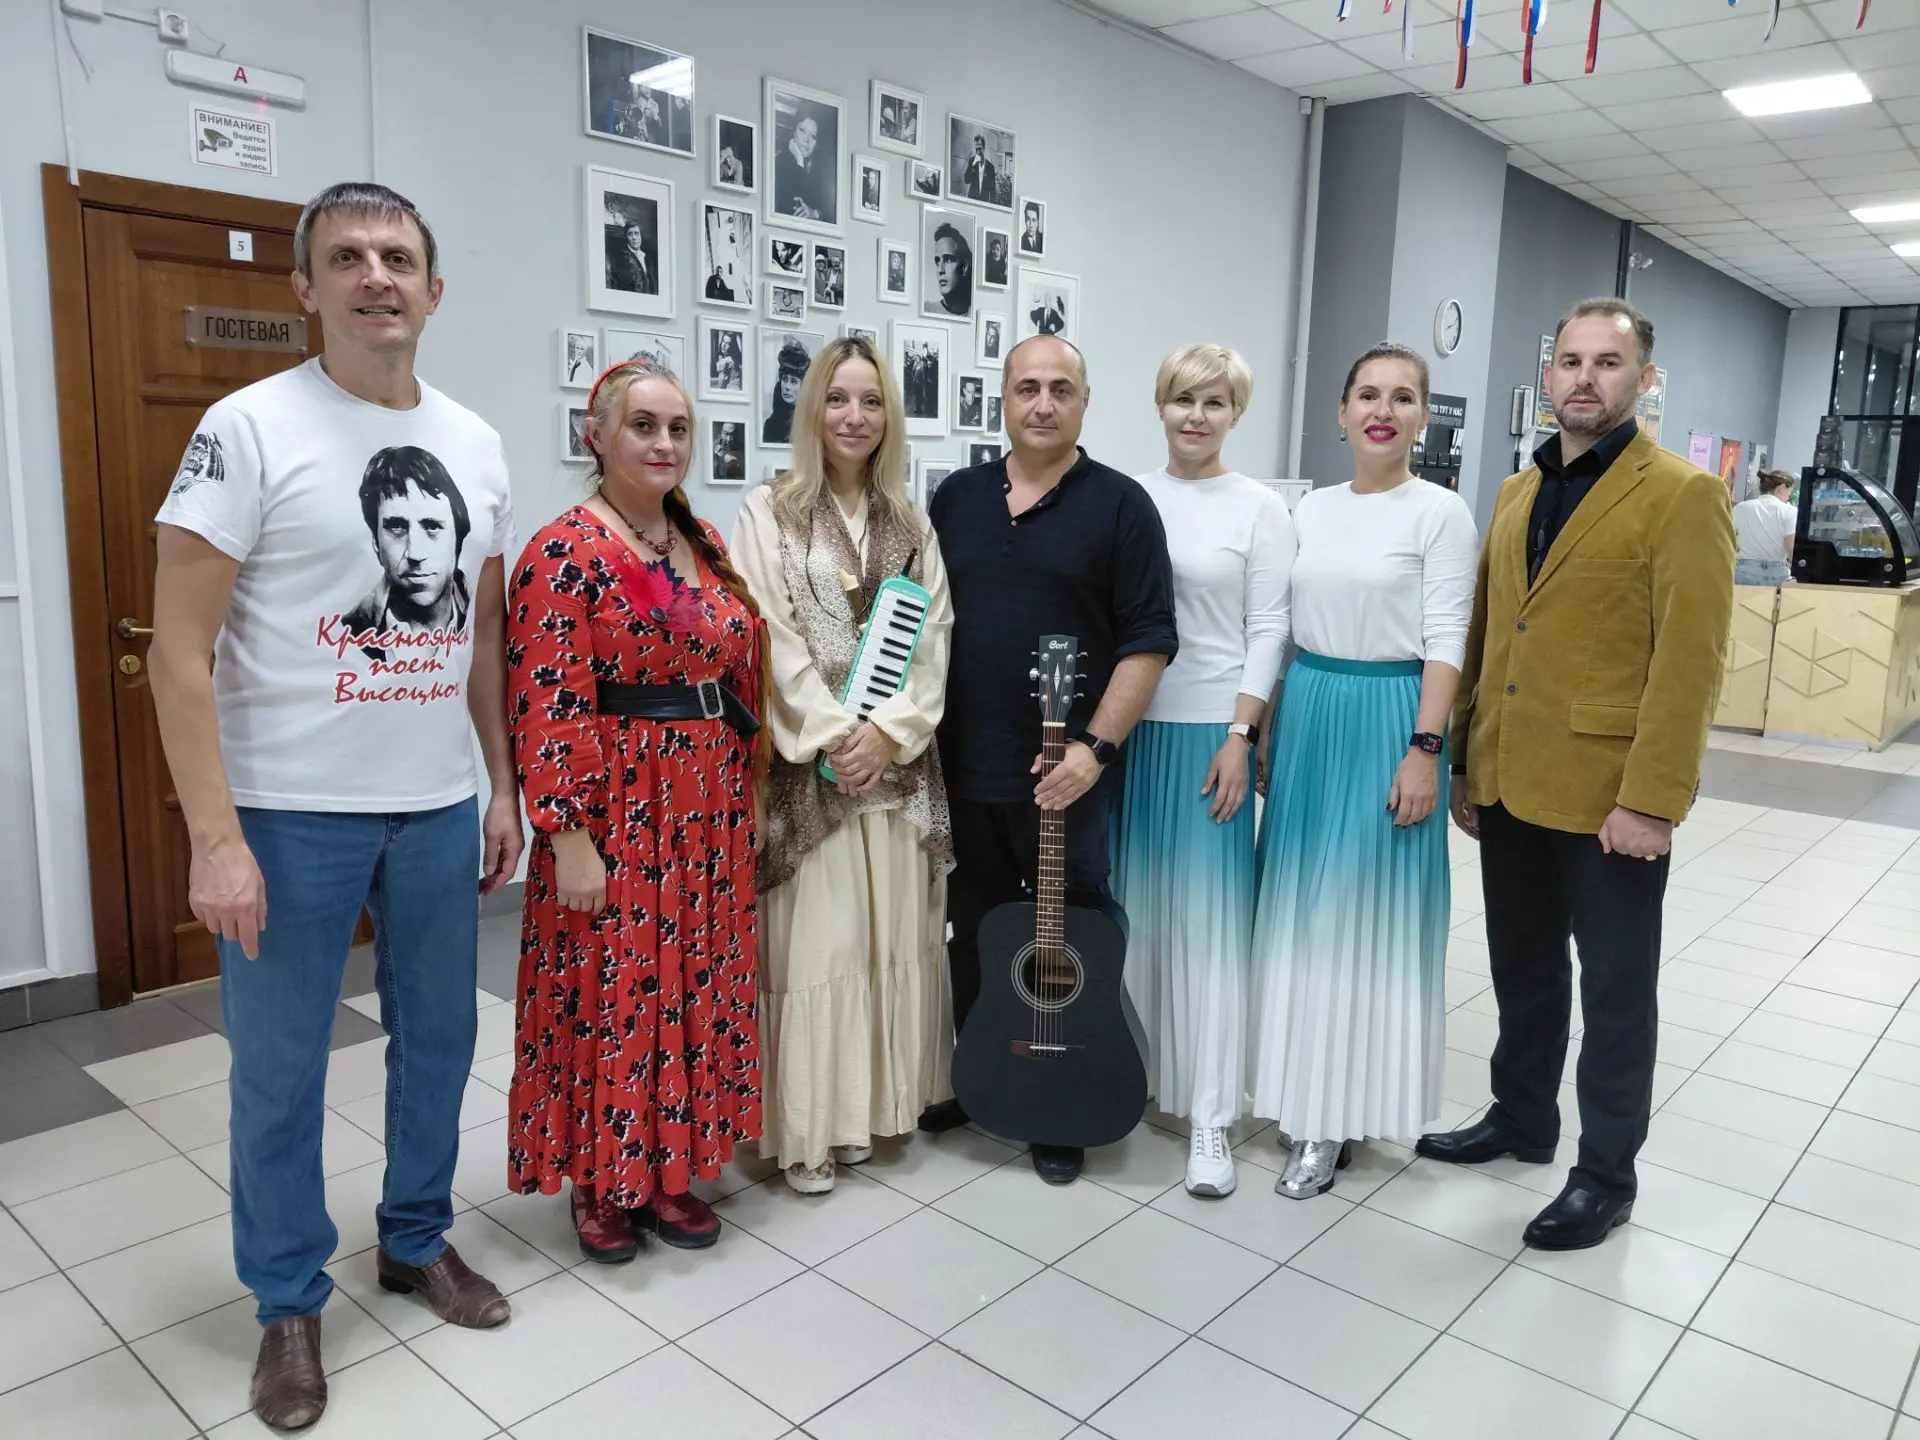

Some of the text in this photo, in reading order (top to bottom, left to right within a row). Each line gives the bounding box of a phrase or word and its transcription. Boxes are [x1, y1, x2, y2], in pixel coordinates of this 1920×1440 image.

[199, 112, 266, 134] ВНИМАНИЕ!
[242, 143, 267, 152] аудио
[242, 153, 267, 161] видео
[239, 160, 267, 170] запись
[237, 240, 245, 252] 5
[205, 316, 290, 343] ГОСТЕВАЯ
[1453, 407, 1464, 417] НАС
[1048, 639, 1069, 650] Cort
[368, 657, 445, 677] поет
